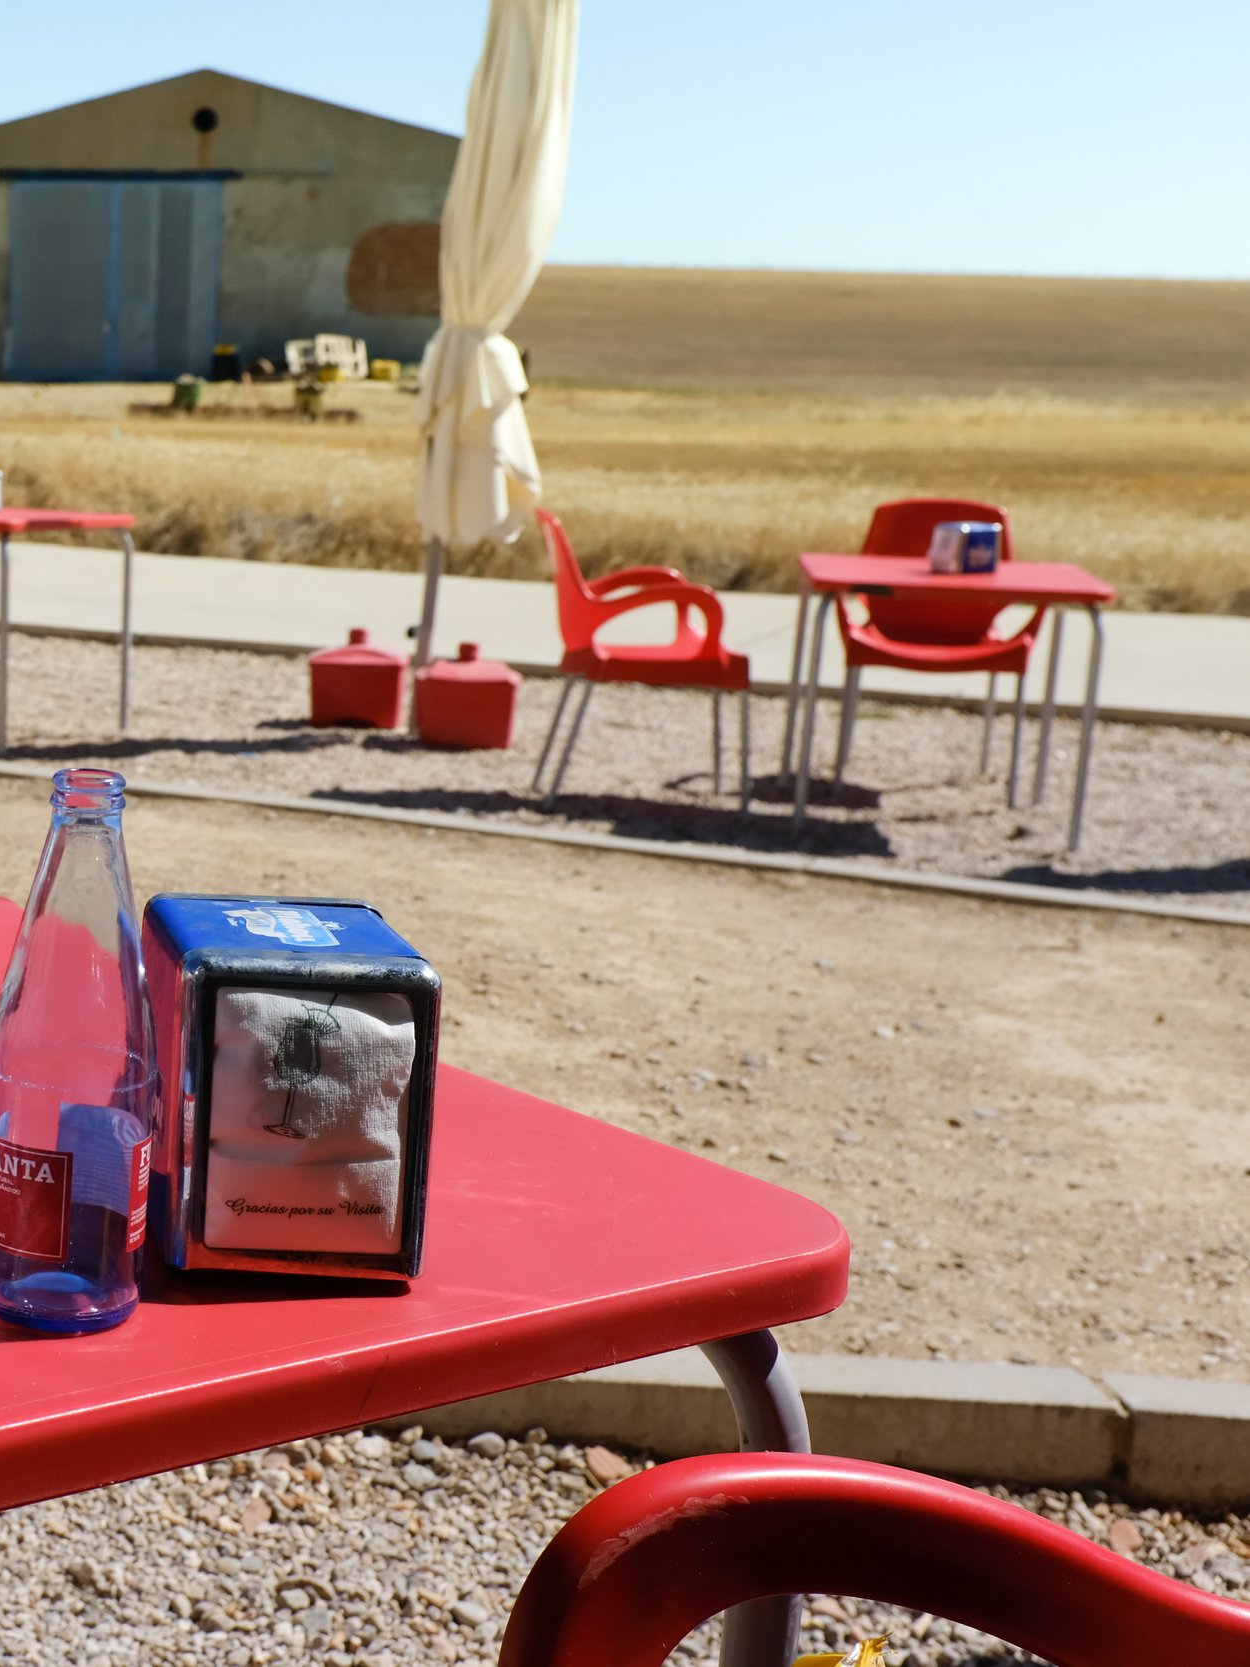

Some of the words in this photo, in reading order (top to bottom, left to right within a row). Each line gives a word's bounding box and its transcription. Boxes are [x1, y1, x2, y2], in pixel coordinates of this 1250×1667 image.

[225, 1198, 289, 1217] Gracias
[288, 1206, 315, 1219] por
[317, 1206, 336, 1216] su
[338, 1200, 385, 1216] Visita
